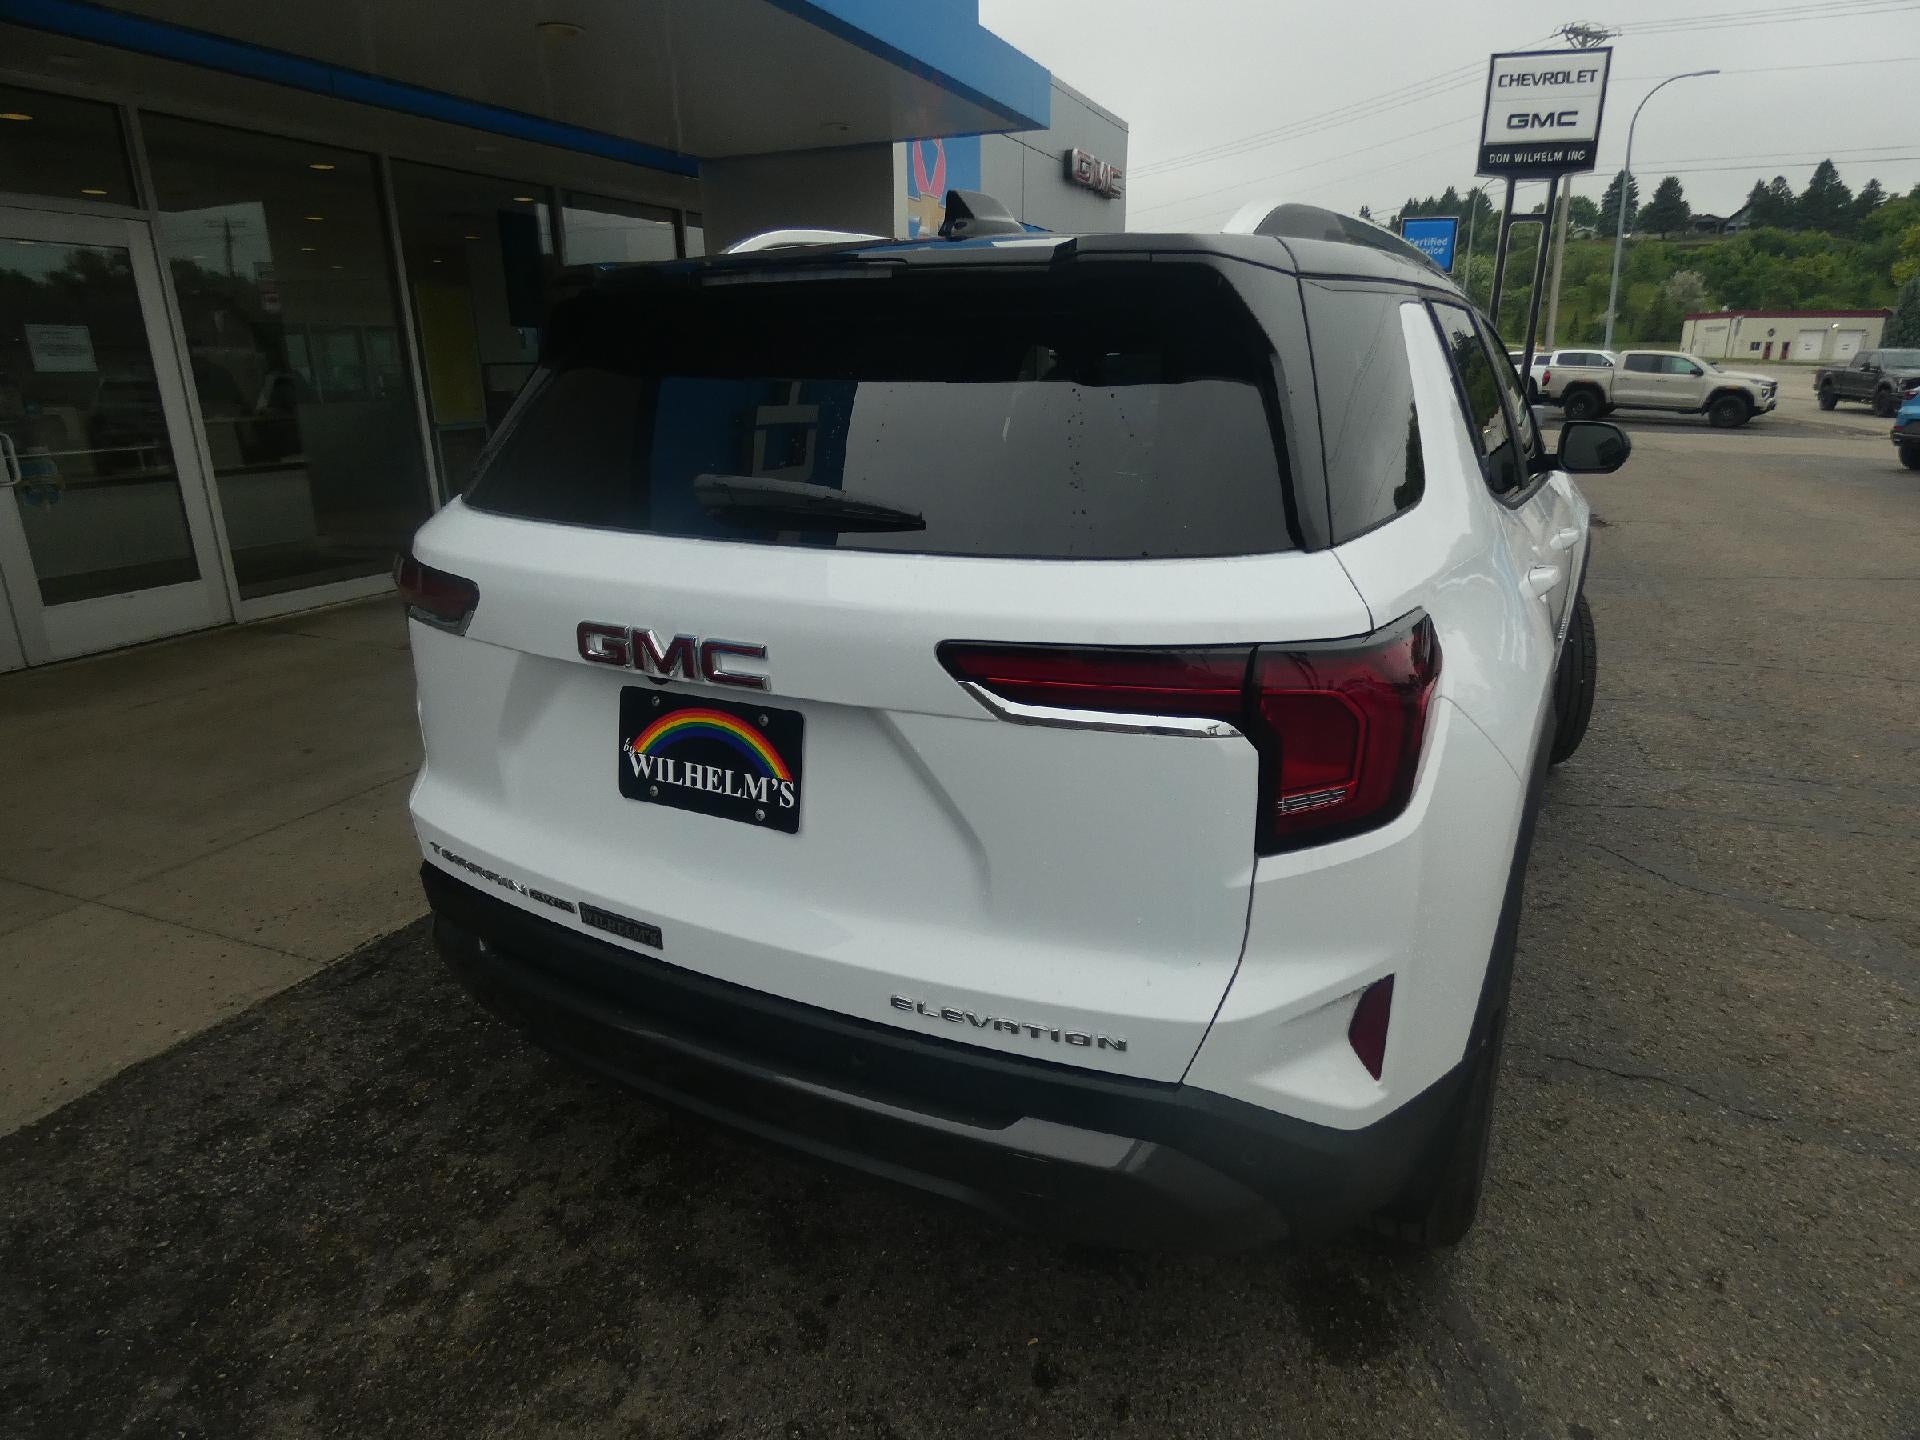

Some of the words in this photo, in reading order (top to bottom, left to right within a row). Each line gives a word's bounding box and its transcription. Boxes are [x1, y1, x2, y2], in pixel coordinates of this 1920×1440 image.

[1497, 69, 1598, 88] CHEVROLET
[1506, 110, 1579, 130] GMC
[1068, 147, 1122, 197] GMC
[1488, 153, 1510, 164] DON
[1514, 151, 1563, 163] WILHELM
[1567, 150, 1586, 161] INC
[576, 619, 771, 691] GMC
[628, 751, 795, 808] WILHELM'S
[890, 994, 1128, 1052] ELEVATION
